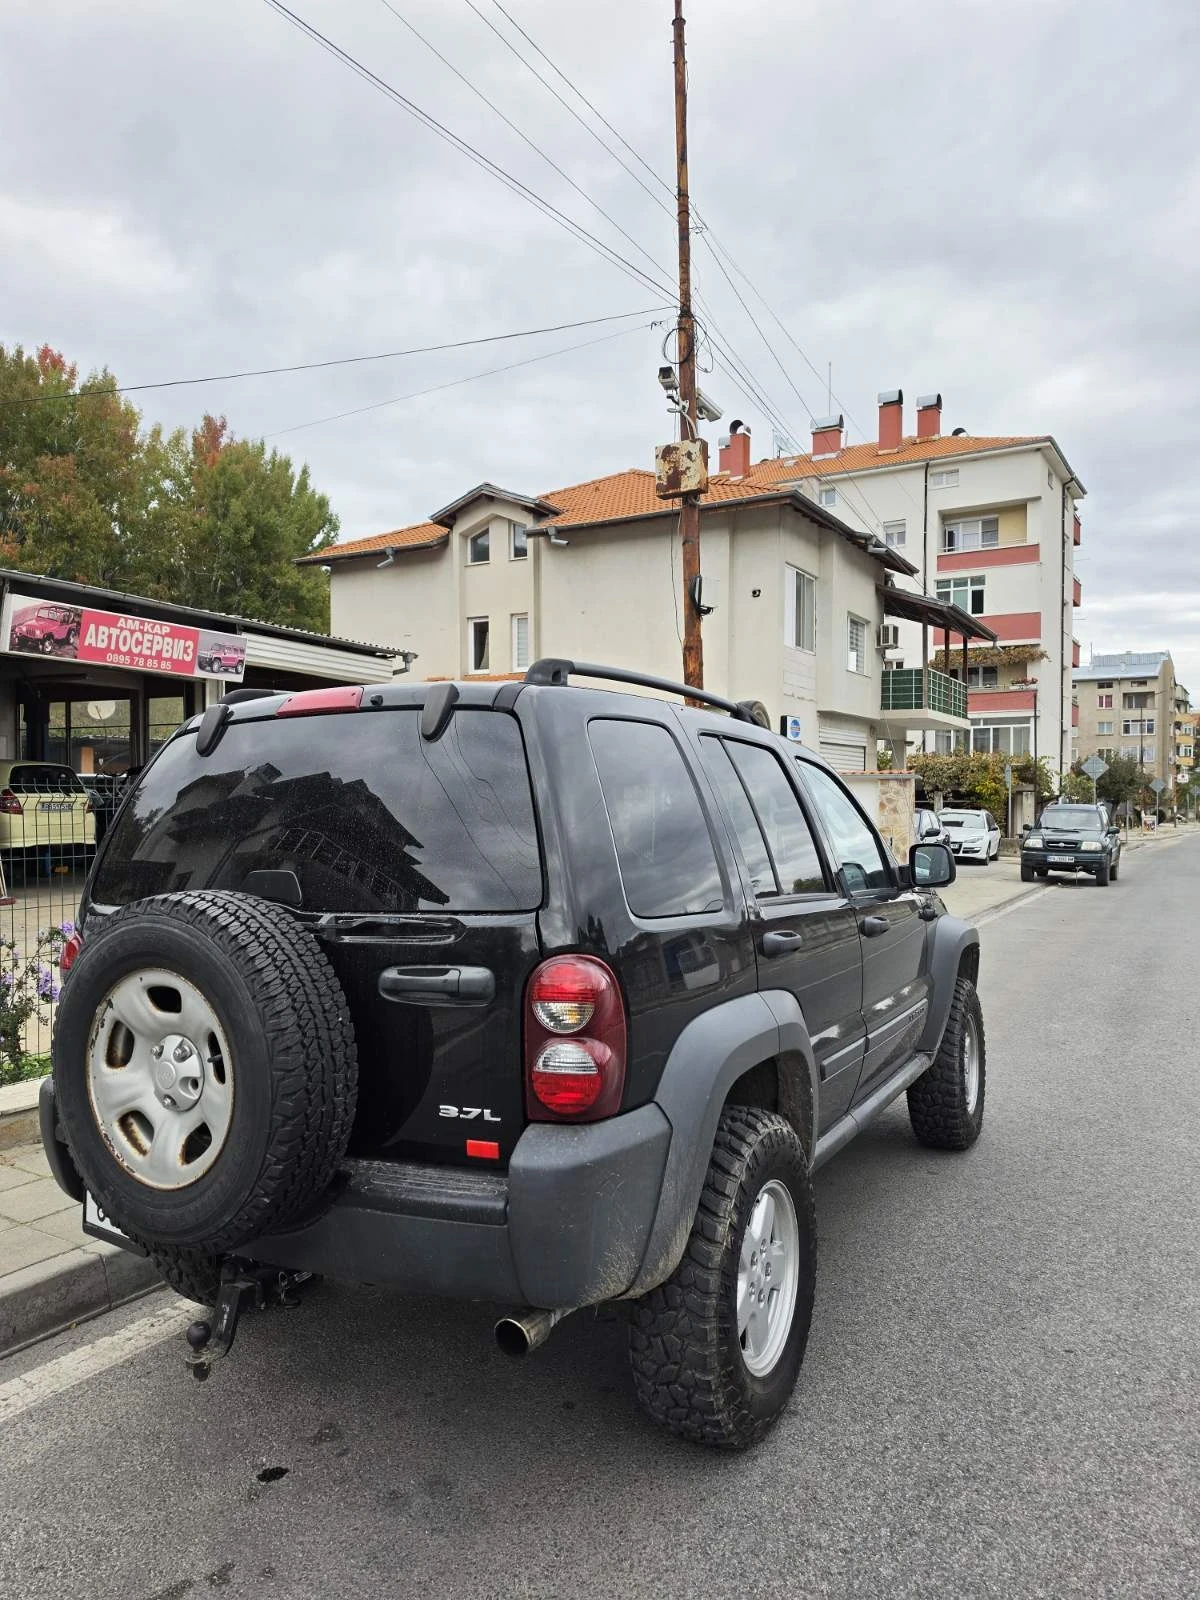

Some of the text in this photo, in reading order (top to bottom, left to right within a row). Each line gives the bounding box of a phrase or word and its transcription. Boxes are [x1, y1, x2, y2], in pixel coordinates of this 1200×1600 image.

[117, 617, 171, 635] АМ-КАР
[84, 623, 194, 662] АВТОСЕРВИЗ
[106, 652, 172, 670] 0895 78 85 85
